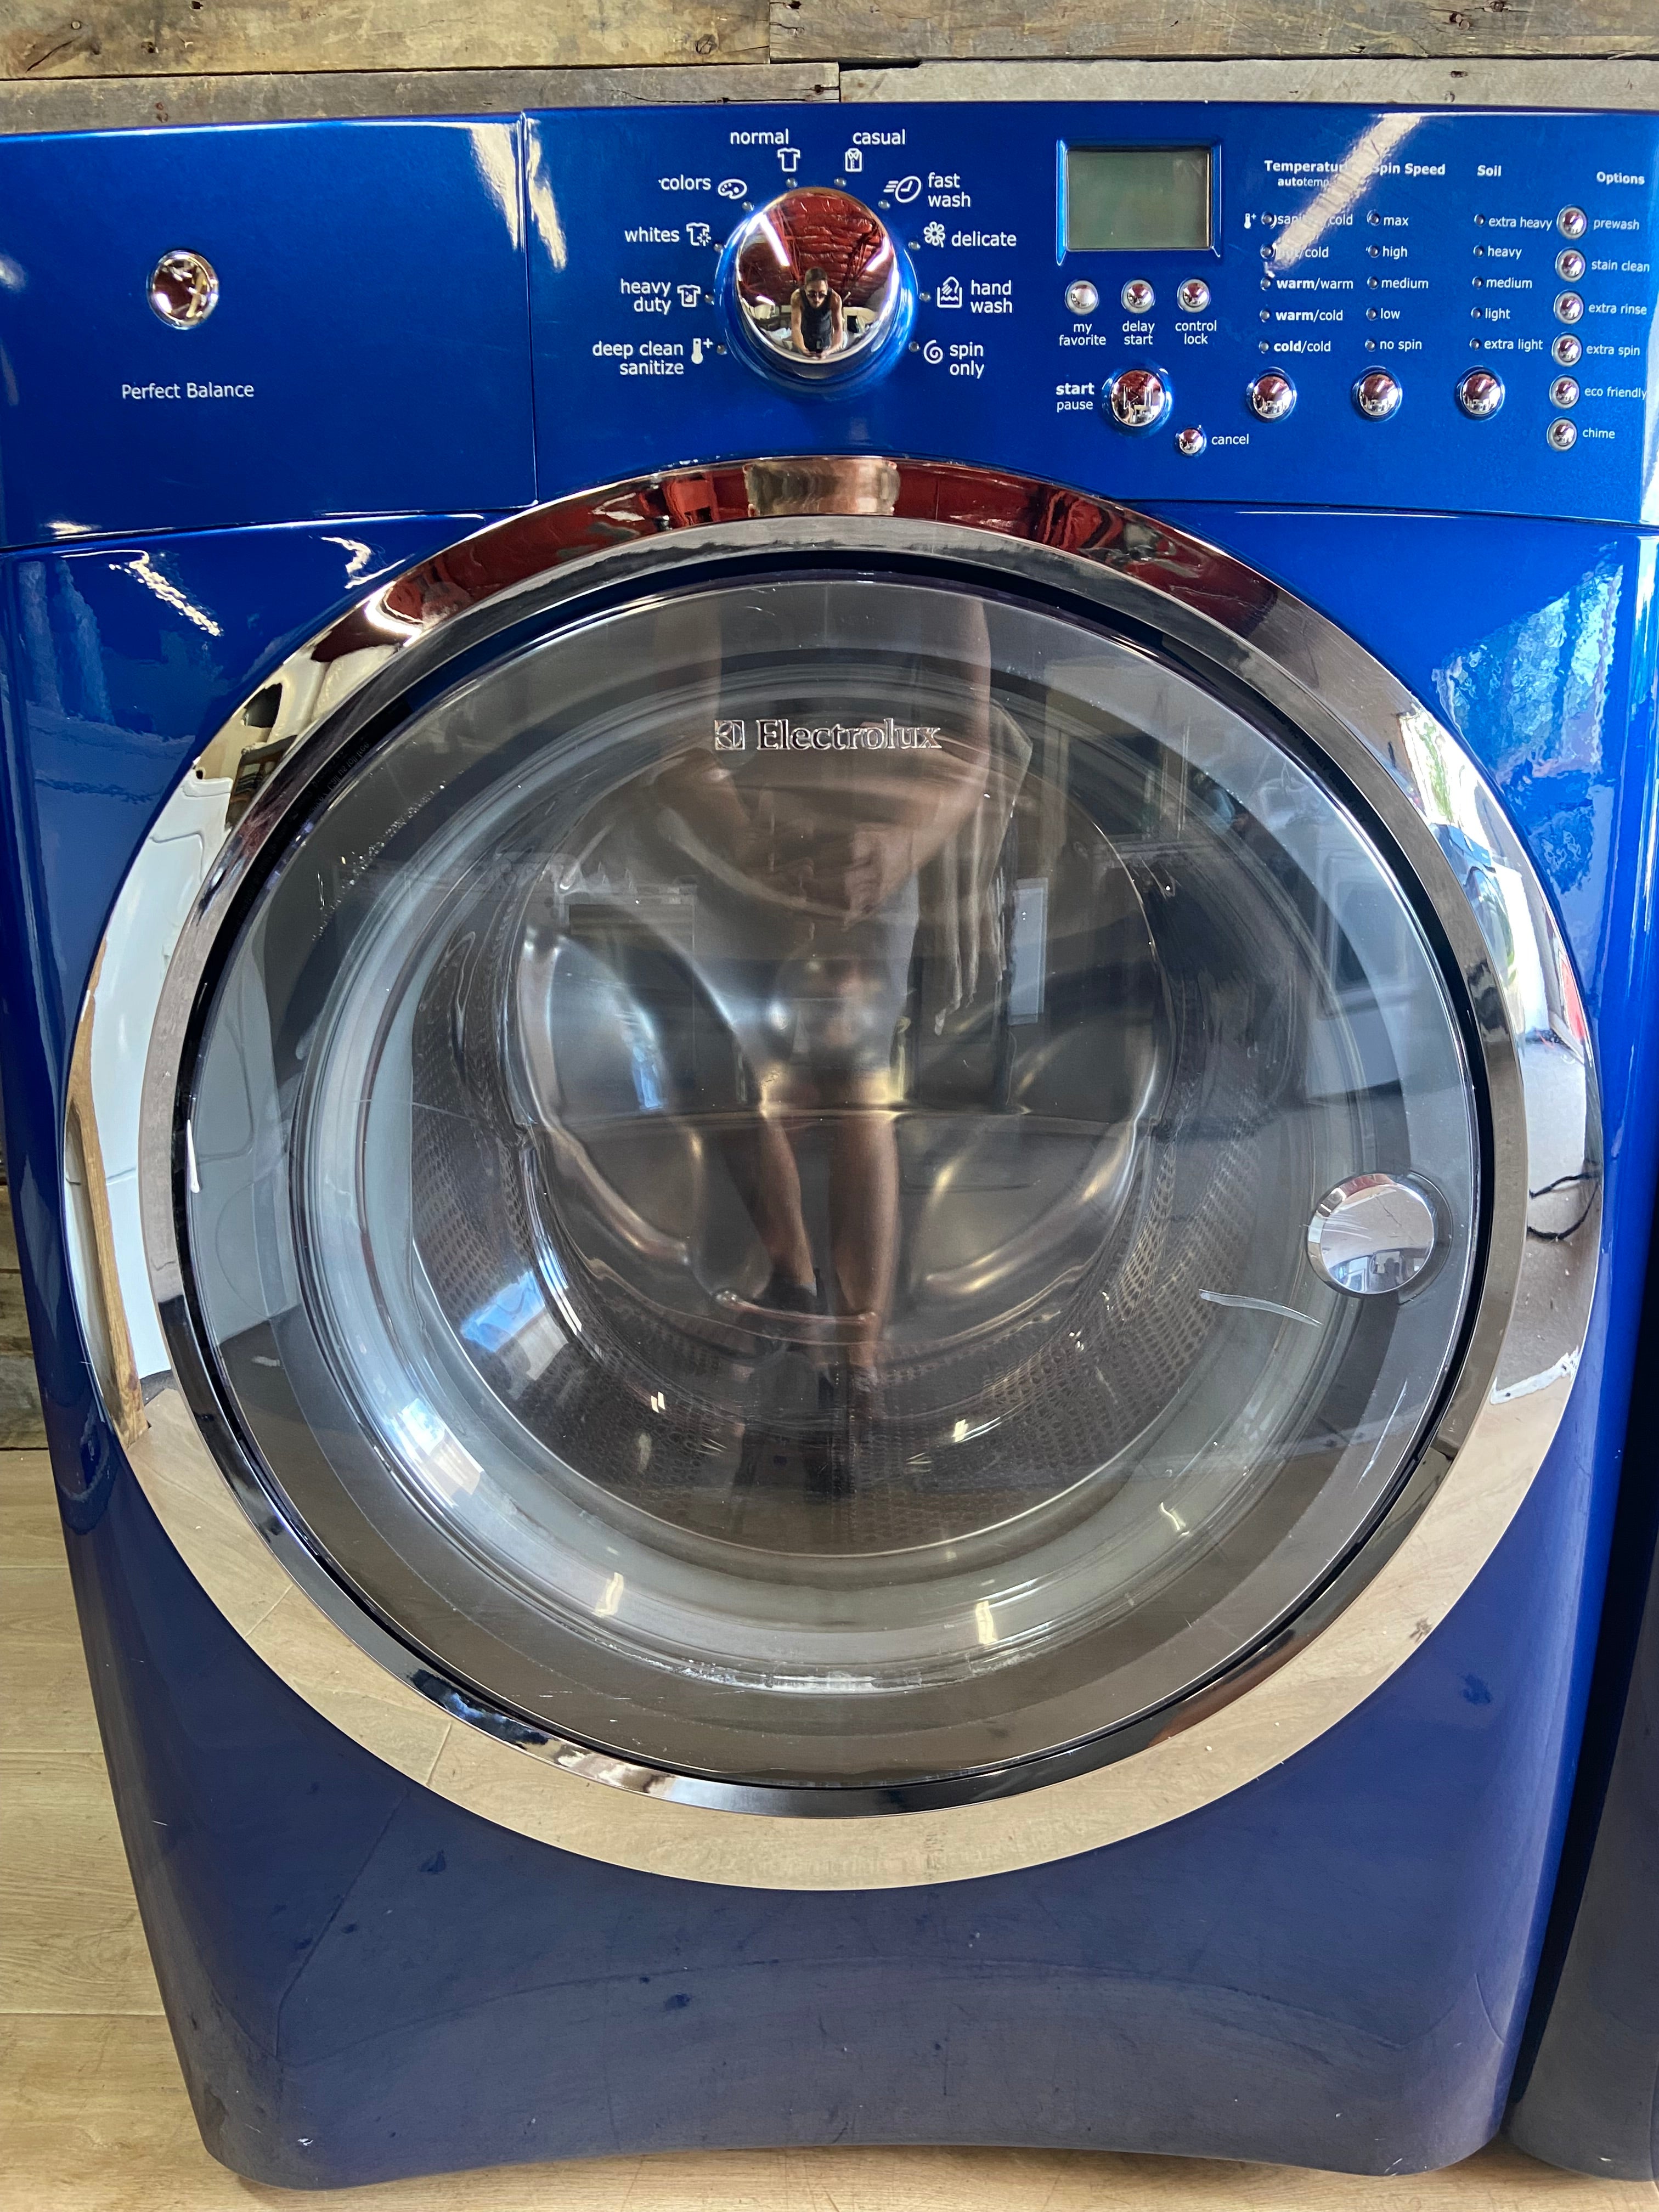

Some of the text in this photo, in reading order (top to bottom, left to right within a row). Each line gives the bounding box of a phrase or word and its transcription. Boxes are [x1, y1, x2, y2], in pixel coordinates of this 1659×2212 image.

[730, 128, 789, 145] normal
[853, 128, 905, 145] casual
[1264, 160, 1351, 174] Temperatur
[1371, 161, 1446, 177] Spin Speed
[1477, 165, 1502, 177] Soil
[661, 174, 712, 190] colors
[928, 172, 960, 188] fast
[1596, 171, 1645, 185] Options
[928, 191, 970, 207] wash
[1277, 213, 1353, 227] sanicold
[1383, 217, 1409, 226] max
[1488, 216, 1553, 231] extra heavy
[1593, 219, 1640, 230] prewash
[624, 227, 680, 242] whites
[951, 230, 1017, 247] delicate
[1383, 245, 1408, 260] high
[1487, 245, 1522, 260] heavy
[1591, 259, 1650, 272] stain clean
[620, 278, 672, 297] heavy
[971, 279, 1012, 296] hand
[1276, 278, 1353, 291] warm/warm
[1381, 277, 1429, 289] medium
[1486, 277, 1532, 289] medium
[633, 296, 672, 315] duty
[970, 297, 1013, 313] wash
[1588, 303, 1647, 315] extra rinse
[1276, 309, 1343, 323] warm/cold
[1380, 308, 1401, 319] low
[1485, 307, 1510, 321] light
[1073, 323, 1092, 335] my
[1122, 320, 1155, 334] delay
[1175, 319, 1217, 331] control
[1059, 334, 1107, 346] favorite
[1124, 334, 1153, 345] start
[1184, 332, 1208, 345] lock
[1380, 339, 1422, 352] no spin
[1484, 338, 1543, 352] extra light
[592, 340, 684, 360] deep clean
[950, 341, 984, 360] spin
[1273, 340, 1331, 353] cold/cold
[1586, 344, 1640, 358] extra spin
[619, 359, 684, 375] sanitize
[950, 360, 985, 379] only
[122, 381, 254, 399] Perfect Balance
[1056, 382, 1094, 396] start
[1584, 387, 1646, 400] eco friendly
[1057, 400, 1093, 413] pause
[1211, 433, 1249, 445] cancel
[1582, 427, 1615, 439] chime
[756, 718, 942, 750] Electrolux
